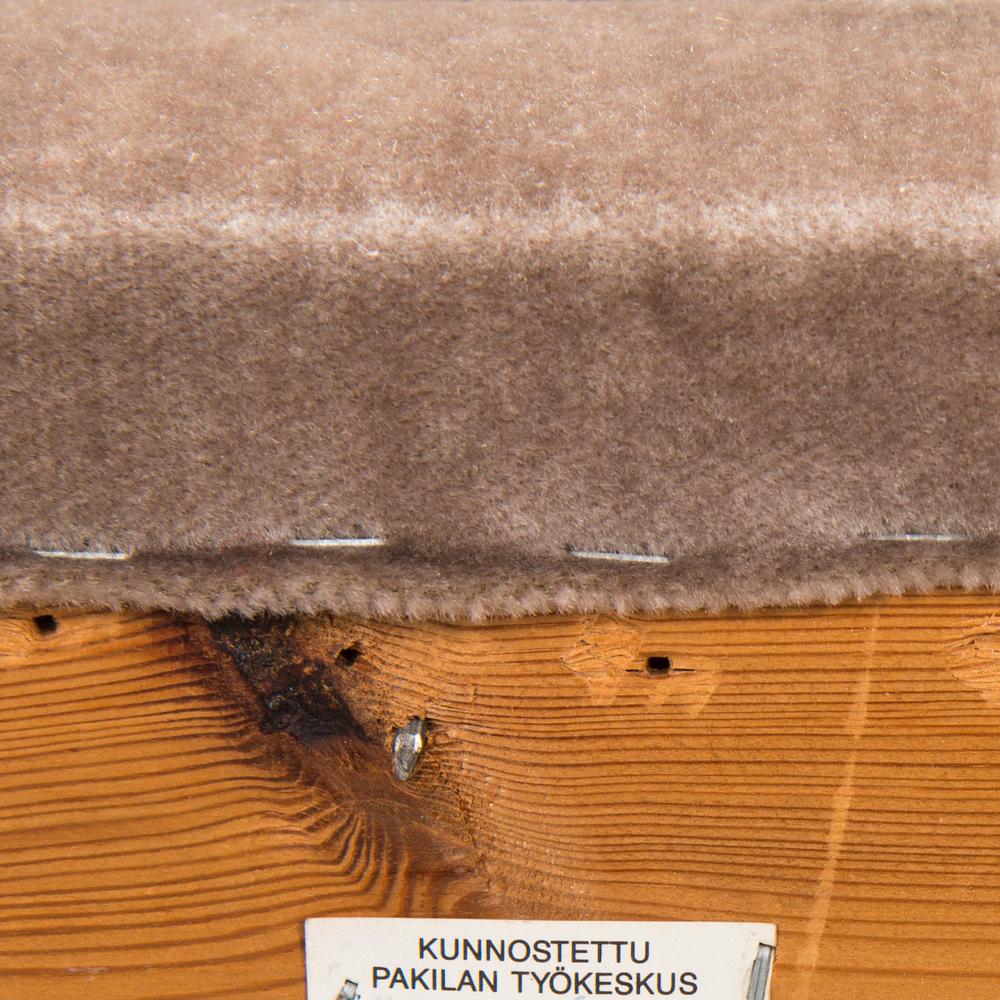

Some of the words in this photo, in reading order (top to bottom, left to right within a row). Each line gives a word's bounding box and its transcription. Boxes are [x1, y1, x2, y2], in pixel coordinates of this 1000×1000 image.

[418, 938, 651, 963] KUNNOSTETTU
[372, 967, 498, 993] PAKILAN
[511, 967, 698, 996] TYÖKESKUS
